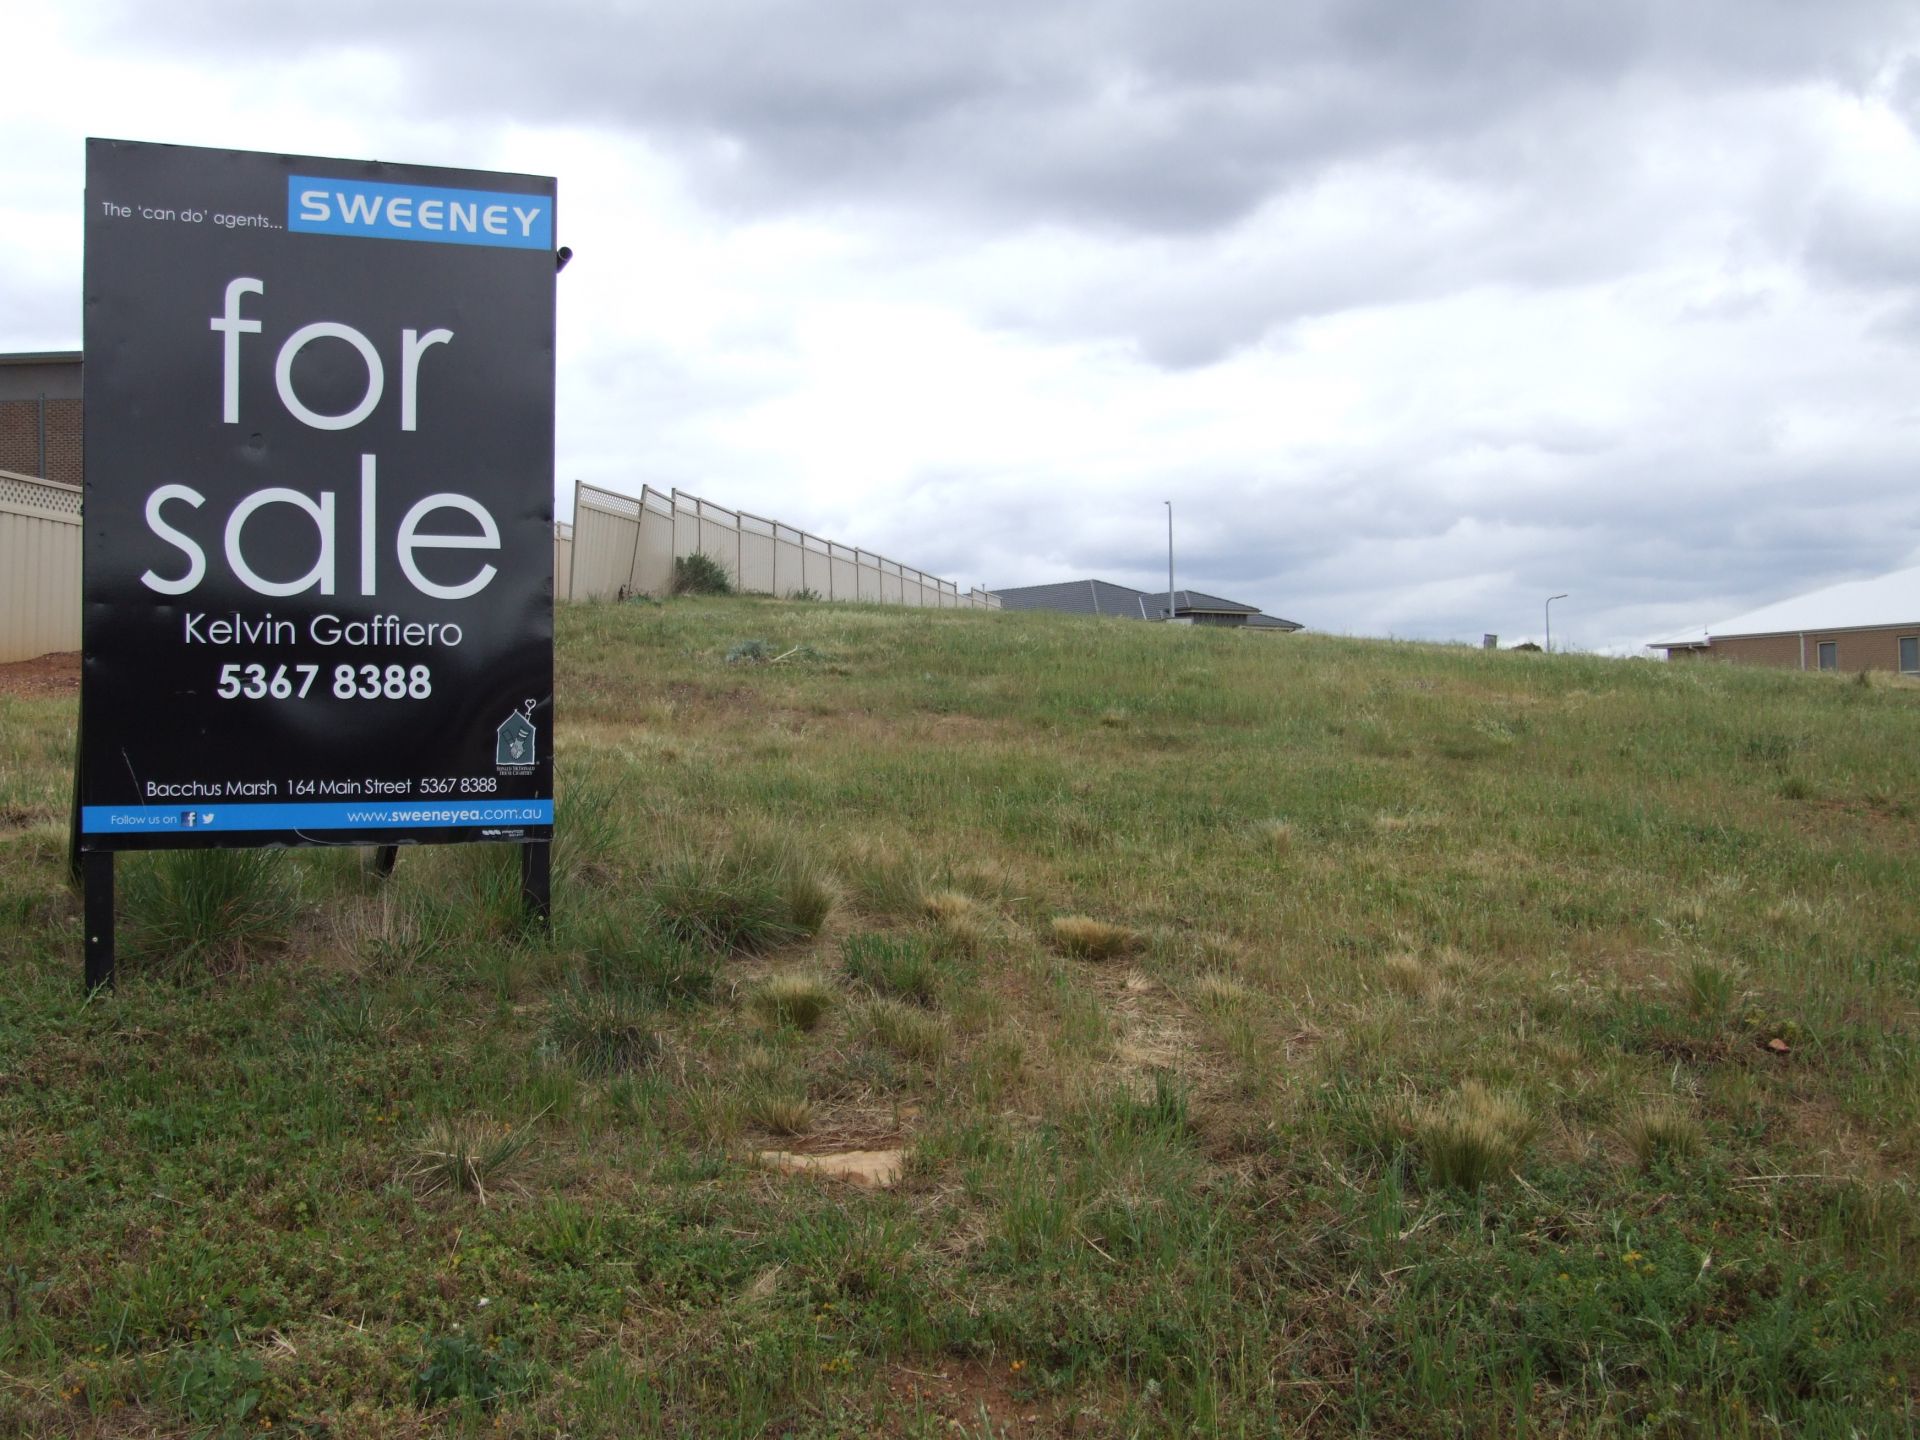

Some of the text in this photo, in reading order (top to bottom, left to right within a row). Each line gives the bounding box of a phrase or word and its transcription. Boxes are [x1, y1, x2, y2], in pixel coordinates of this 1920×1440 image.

[102, 202, 131, 217] The
[214, 214, 282, 229] agents...
[301, 191, 540, 236] SWEENEY
[211, 277, 454, 431] for
[141, 454, 500, 599] sale
[186, 614, 462, 646] Kelvin Gaffiero
[218, 664, 431, 699] 5367 8388
[147, 778, 497, 796] Bacchus Marsh 164 Main Street 5367 8388
[111, 815, 145, 825] Follow
[149, 817, 160, 825] us
[163, 816, 177, 825] on
[348, 809, 541, 823] www.sweeneyea.com.au
